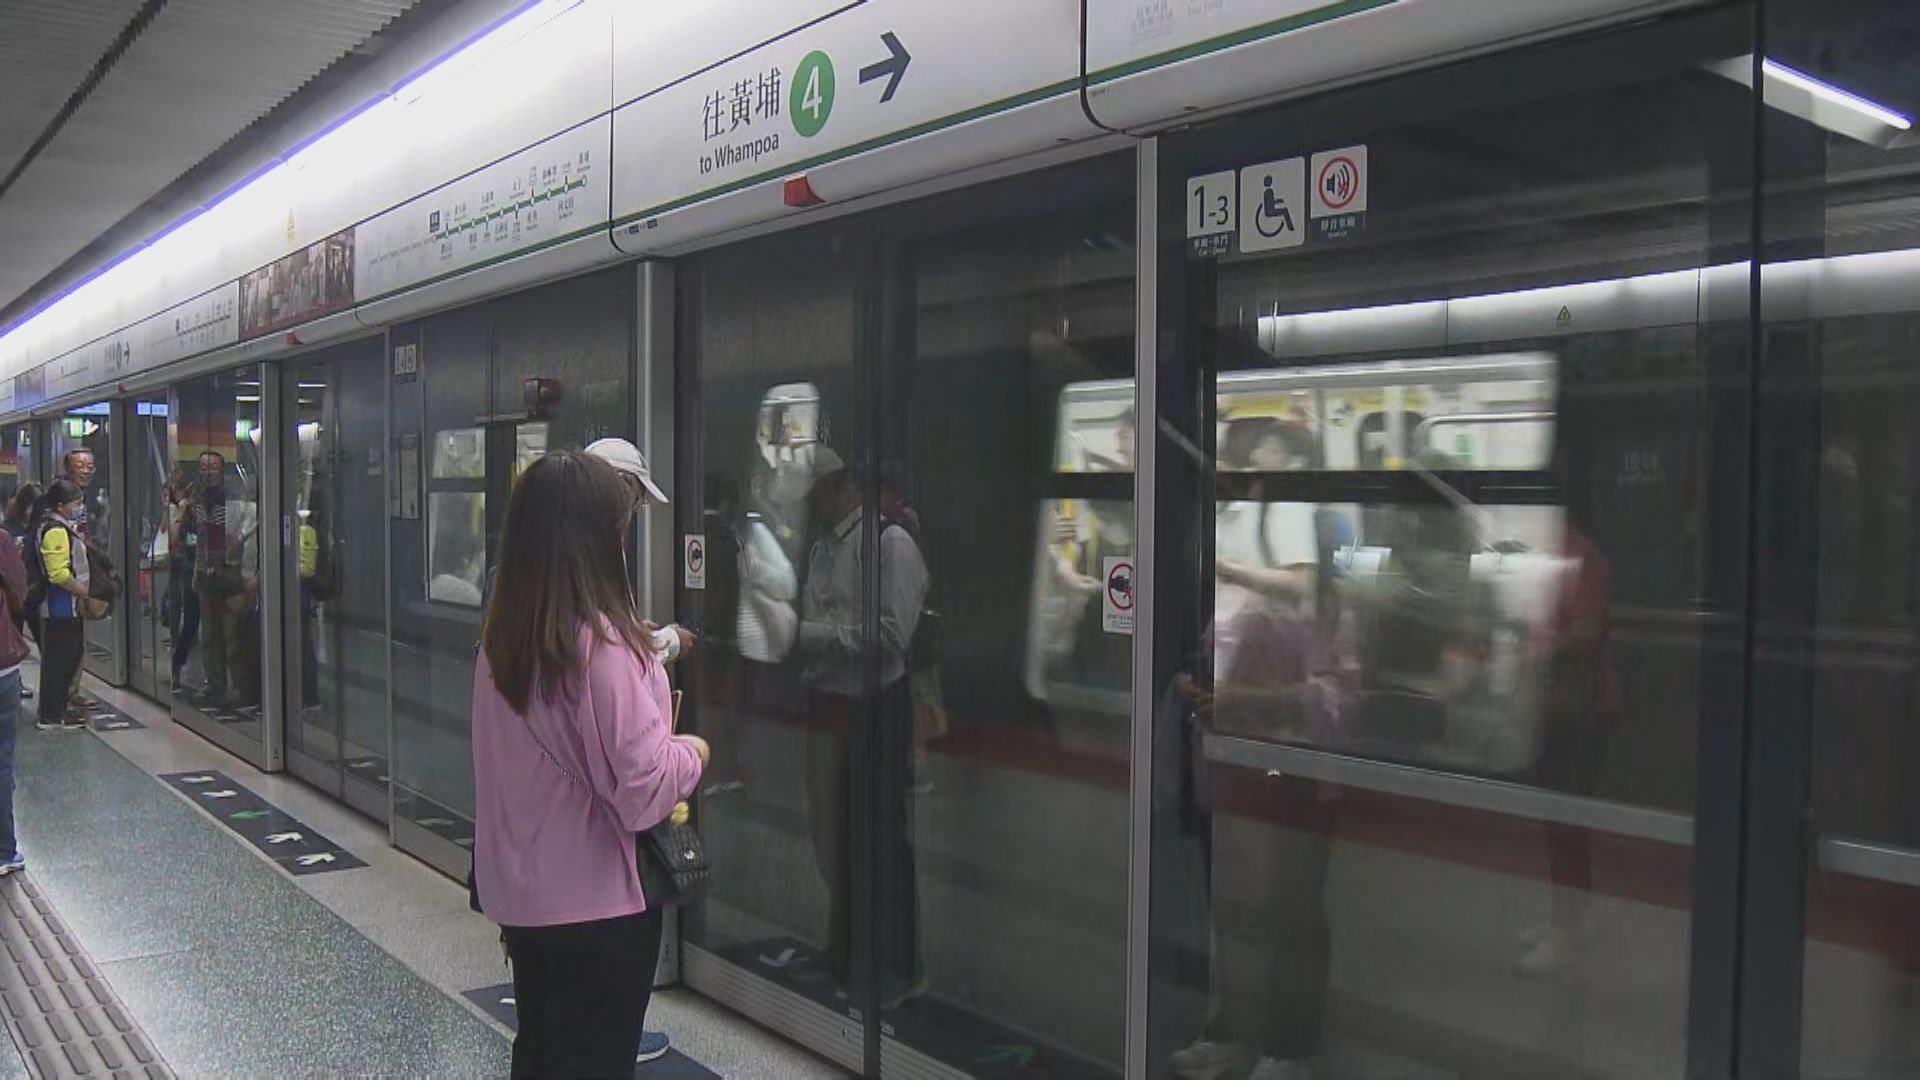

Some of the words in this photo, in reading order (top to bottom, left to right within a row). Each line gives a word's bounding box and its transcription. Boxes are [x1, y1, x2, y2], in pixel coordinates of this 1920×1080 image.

[702, 65, 782, 142] 往黃埔
[800, 65, 823, 120] 4
[699, 155, 712, 175] to
[714, 132, 780, 169] Whampoa
[1193, 184, 1229, 229] 1-3
